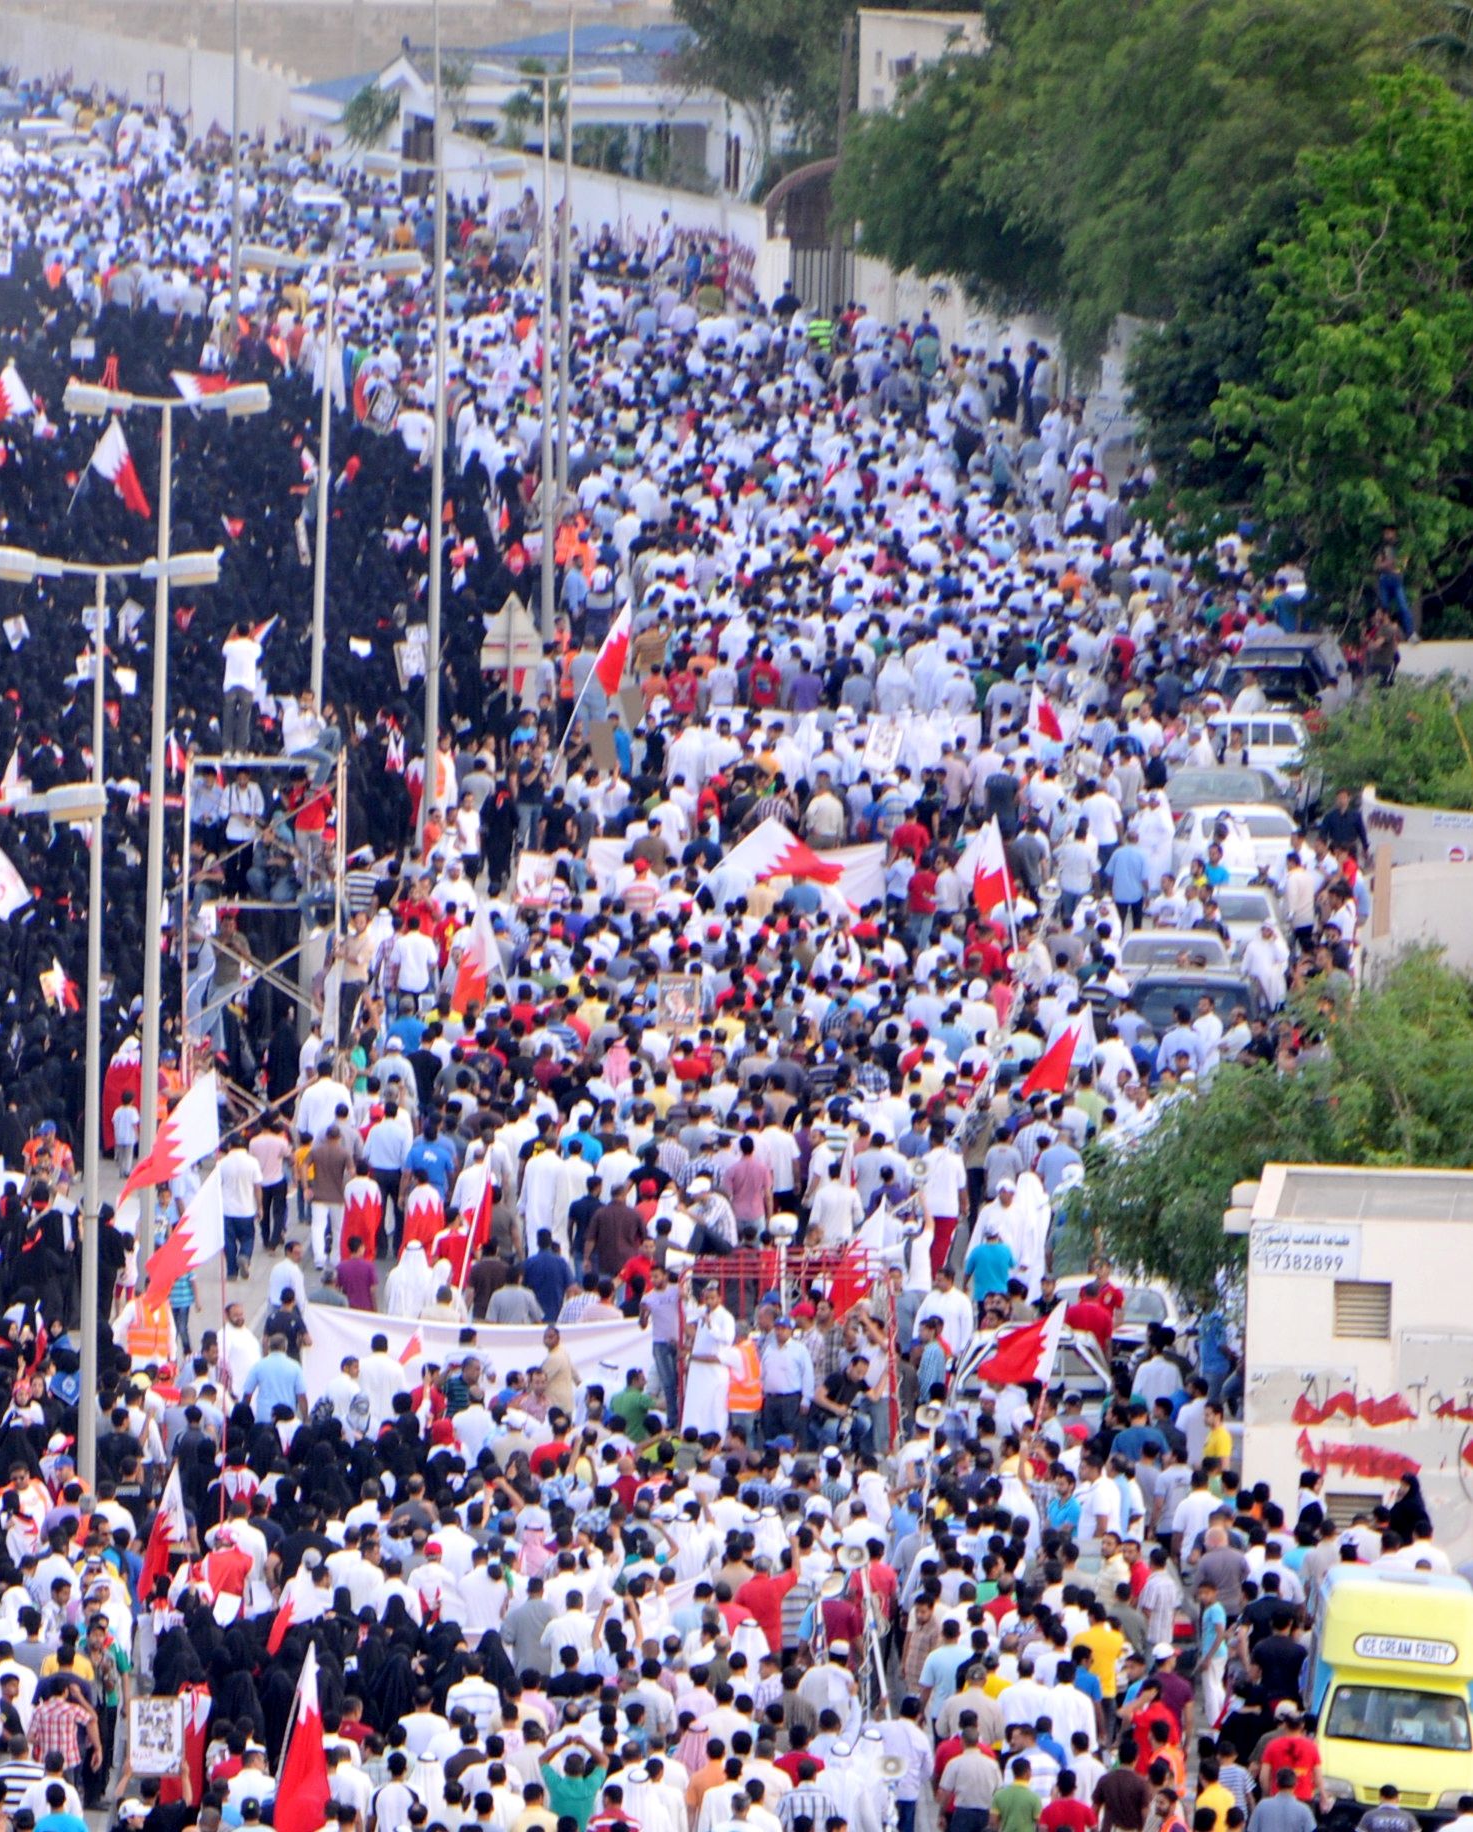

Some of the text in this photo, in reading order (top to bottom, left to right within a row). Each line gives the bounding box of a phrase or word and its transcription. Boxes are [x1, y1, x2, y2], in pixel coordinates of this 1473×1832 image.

[1264, 1253, 1344, 1272] 17382899
[1362, 1637, 1450, 1660] ICE CREAM FRUITY
